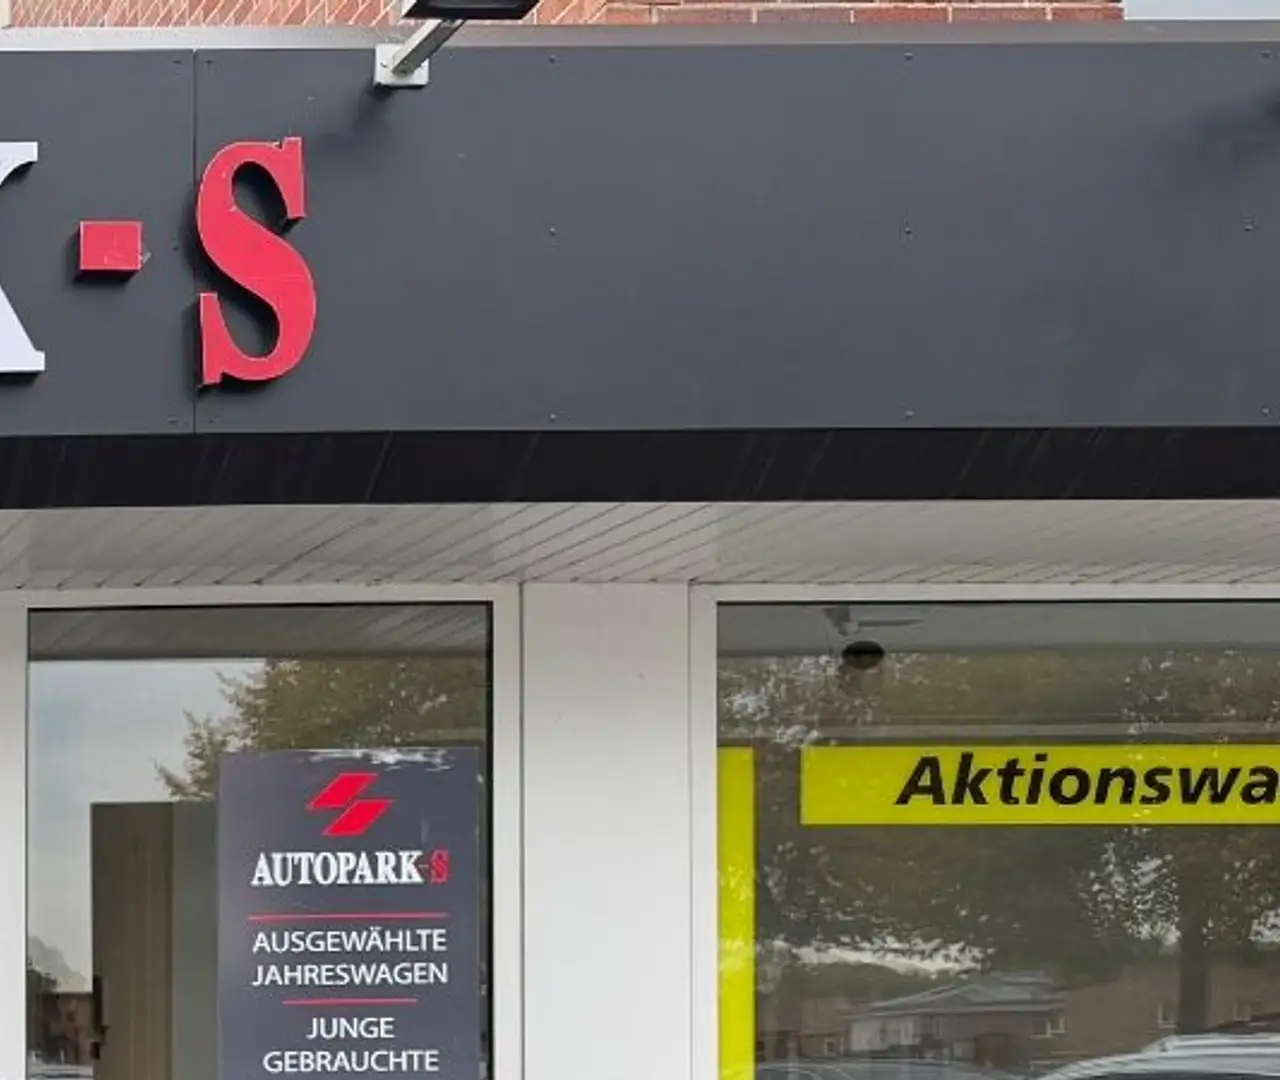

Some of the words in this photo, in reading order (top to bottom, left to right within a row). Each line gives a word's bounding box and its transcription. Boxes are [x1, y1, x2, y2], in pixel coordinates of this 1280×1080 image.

[896, 753, 1278, 806] Aktionswa
[252, 926, 447, 954] AUSGEWÄHLTE
[251, 962, 448, 987] JAHRESWAGEN
[306, 1017, 395, 1040] JUNGE
[262, 1050, 439, 1073] GEBRAUCHTE
